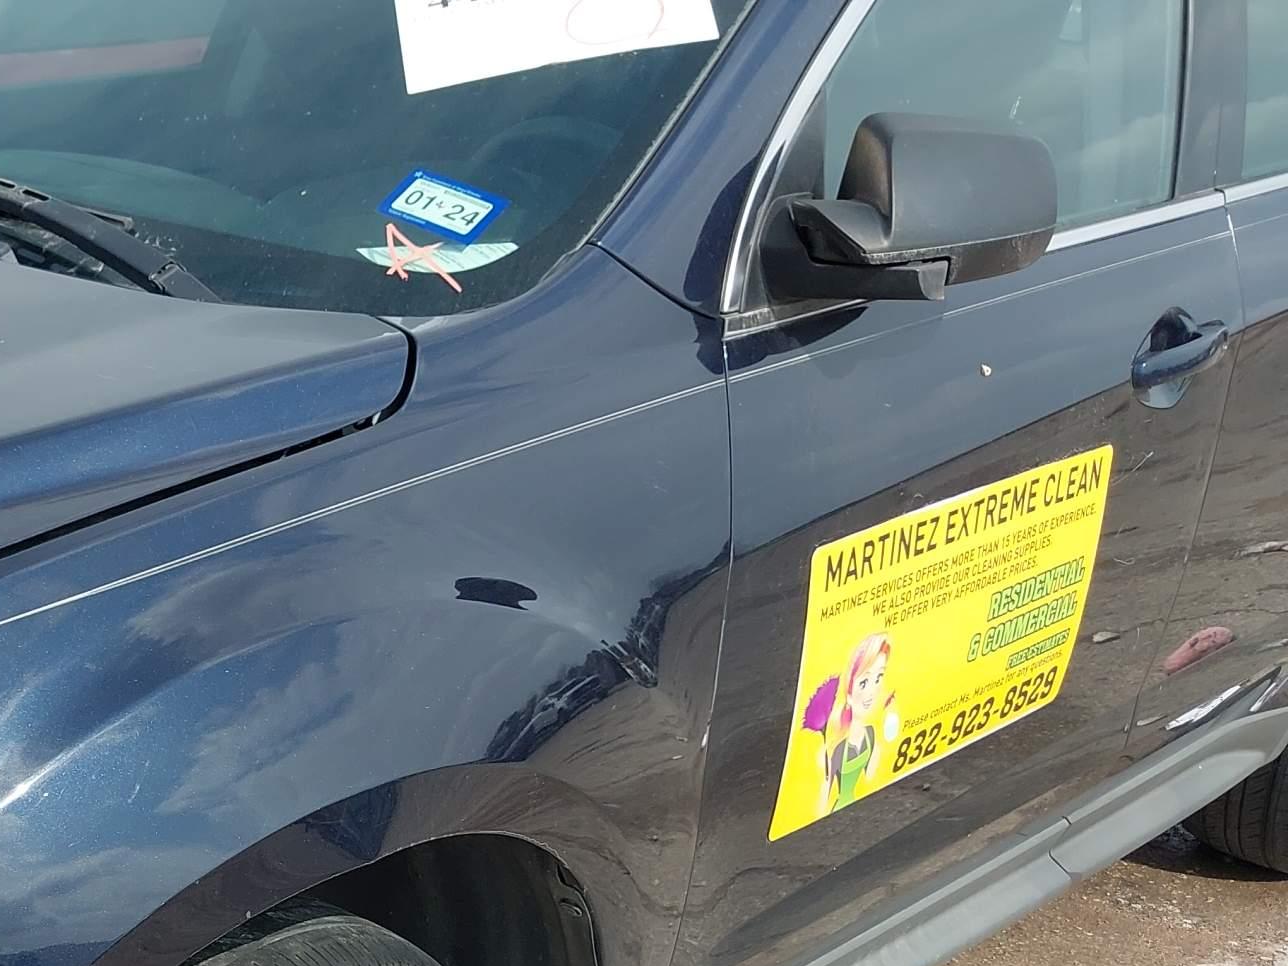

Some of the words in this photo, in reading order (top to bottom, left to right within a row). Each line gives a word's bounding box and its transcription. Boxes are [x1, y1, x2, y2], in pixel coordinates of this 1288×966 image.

[825, 517, 940, 592] MARTINEZ
[945, 479, 1039, 545] EXTREME
[1043, 457, 1102, 504] CLEAN
[821, 590, 869, 622] MARTINEZ
[870, 573, 913, 601] SERVICES
[916, 562, 949, 584] OFFERS
[951, 550, 975, 569] MORE
[977, 542, 1000, 559] THAN
[1002, 535, 1010, 548] 15
[1012, 526, 1037, 545] YEARS
[1038, 521, 1049, 533] OF
[1050, 502, 1097, 530] EXPERIENCE.
[873, 602, 886, 616] WE
[888, 593, 912, 610] ALSO
[914, 578, 951, 602] PROVIDE
[952, 568, 970, 584] OUR
[972, 551, 1013, 578] CLEANING
[987, 556, 1085, 622] RESIDENTIAL
[884, 614, 899, 628] WE
[901, 602, 928, 622] OFFER
[930, 592, 952, 611] VERY
[954, 572, 1007, 604] AFFORDABLE
[967, 633, 981, 662] &
[981, 590, 1078, 656] COMMERCIAL
[892, 666, 1058, 773] 832-923-8529
[903, 710, 928, 731] Please
[930, 698, 958, 719] contact
[959, 692, 970, 706] Ms.
[974, 678, 1004, 698] Martinez
[1005, 669, 1017, 683] for
[1017, 665, 1029, 681] any
